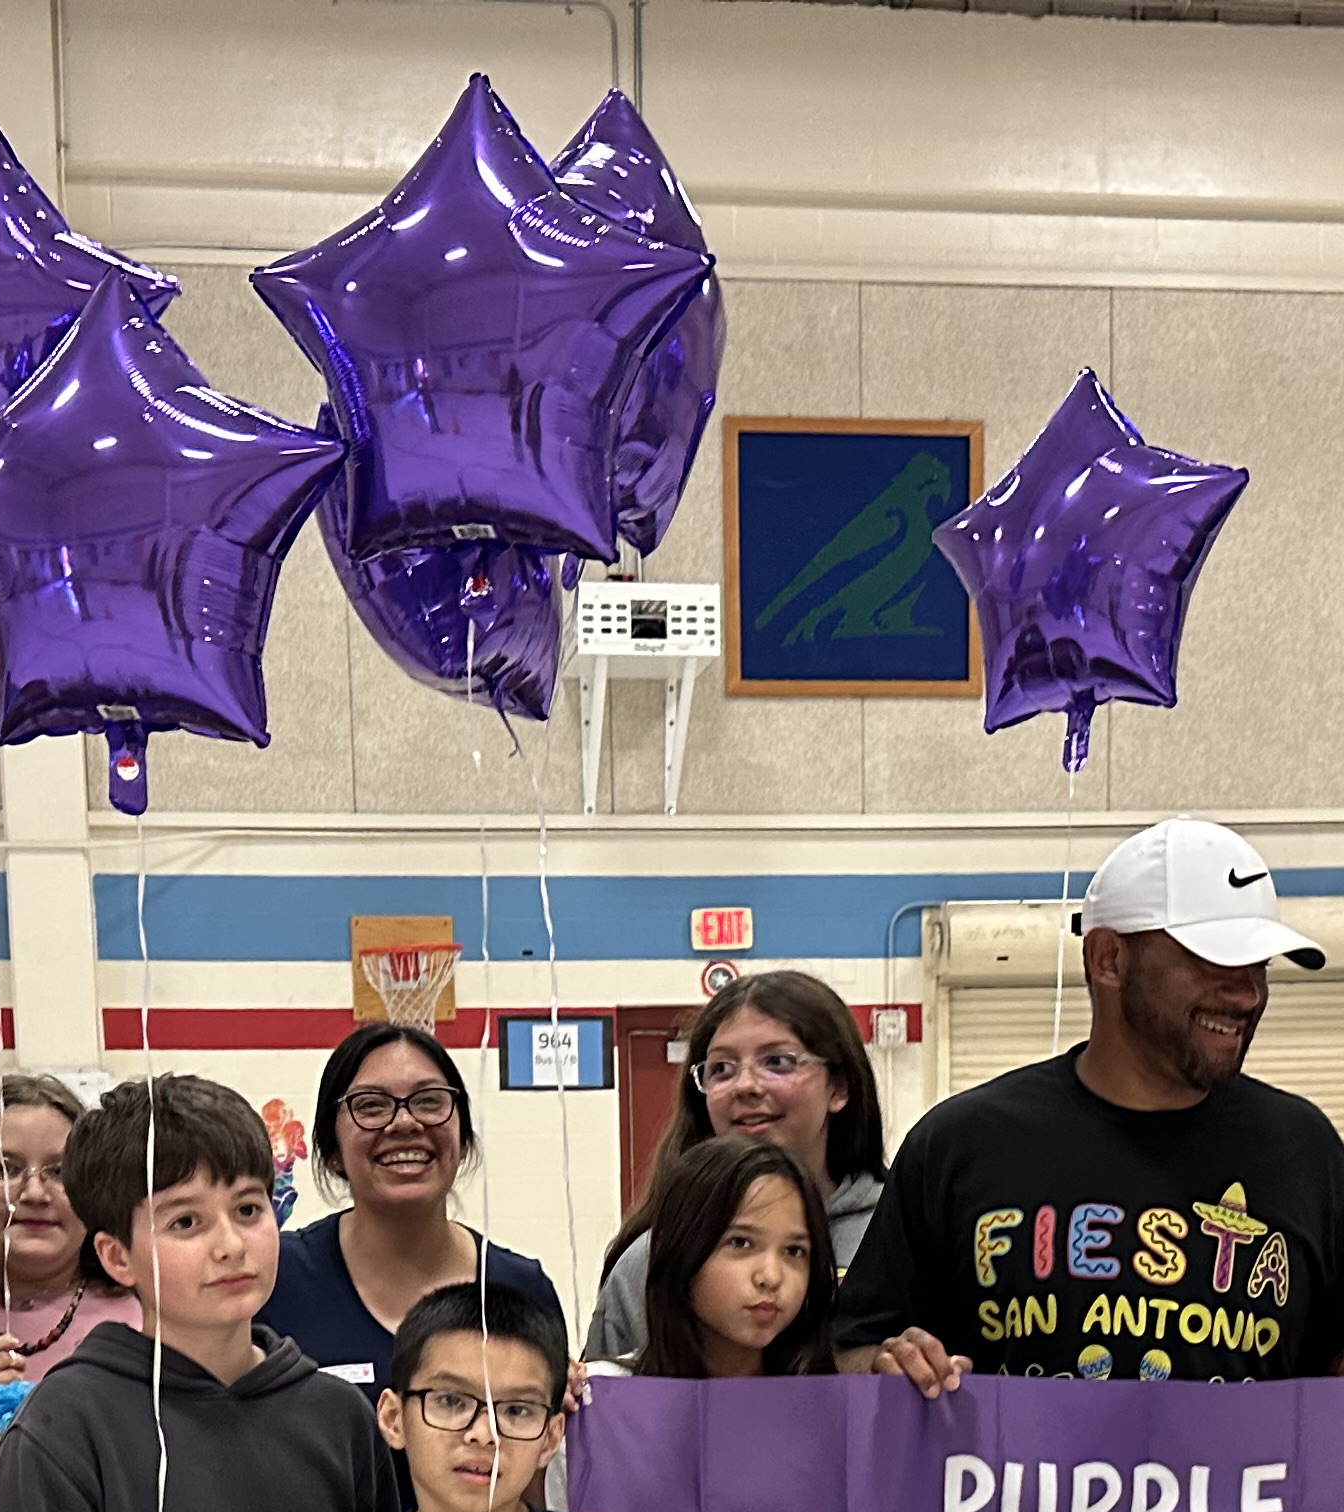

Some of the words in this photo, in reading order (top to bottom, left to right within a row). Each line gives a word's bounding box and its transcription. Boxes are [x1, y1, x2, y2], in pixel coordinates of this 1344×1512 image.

[702, 911, 744, 945] EXIT
[538, 1033, 572, 1049] 964
[975, 1203, 1289, 1307] FIESTA
[978, 1294, 1057, 1342] SAN
[1083, 1294, 1281, 1357] ANTONIO
